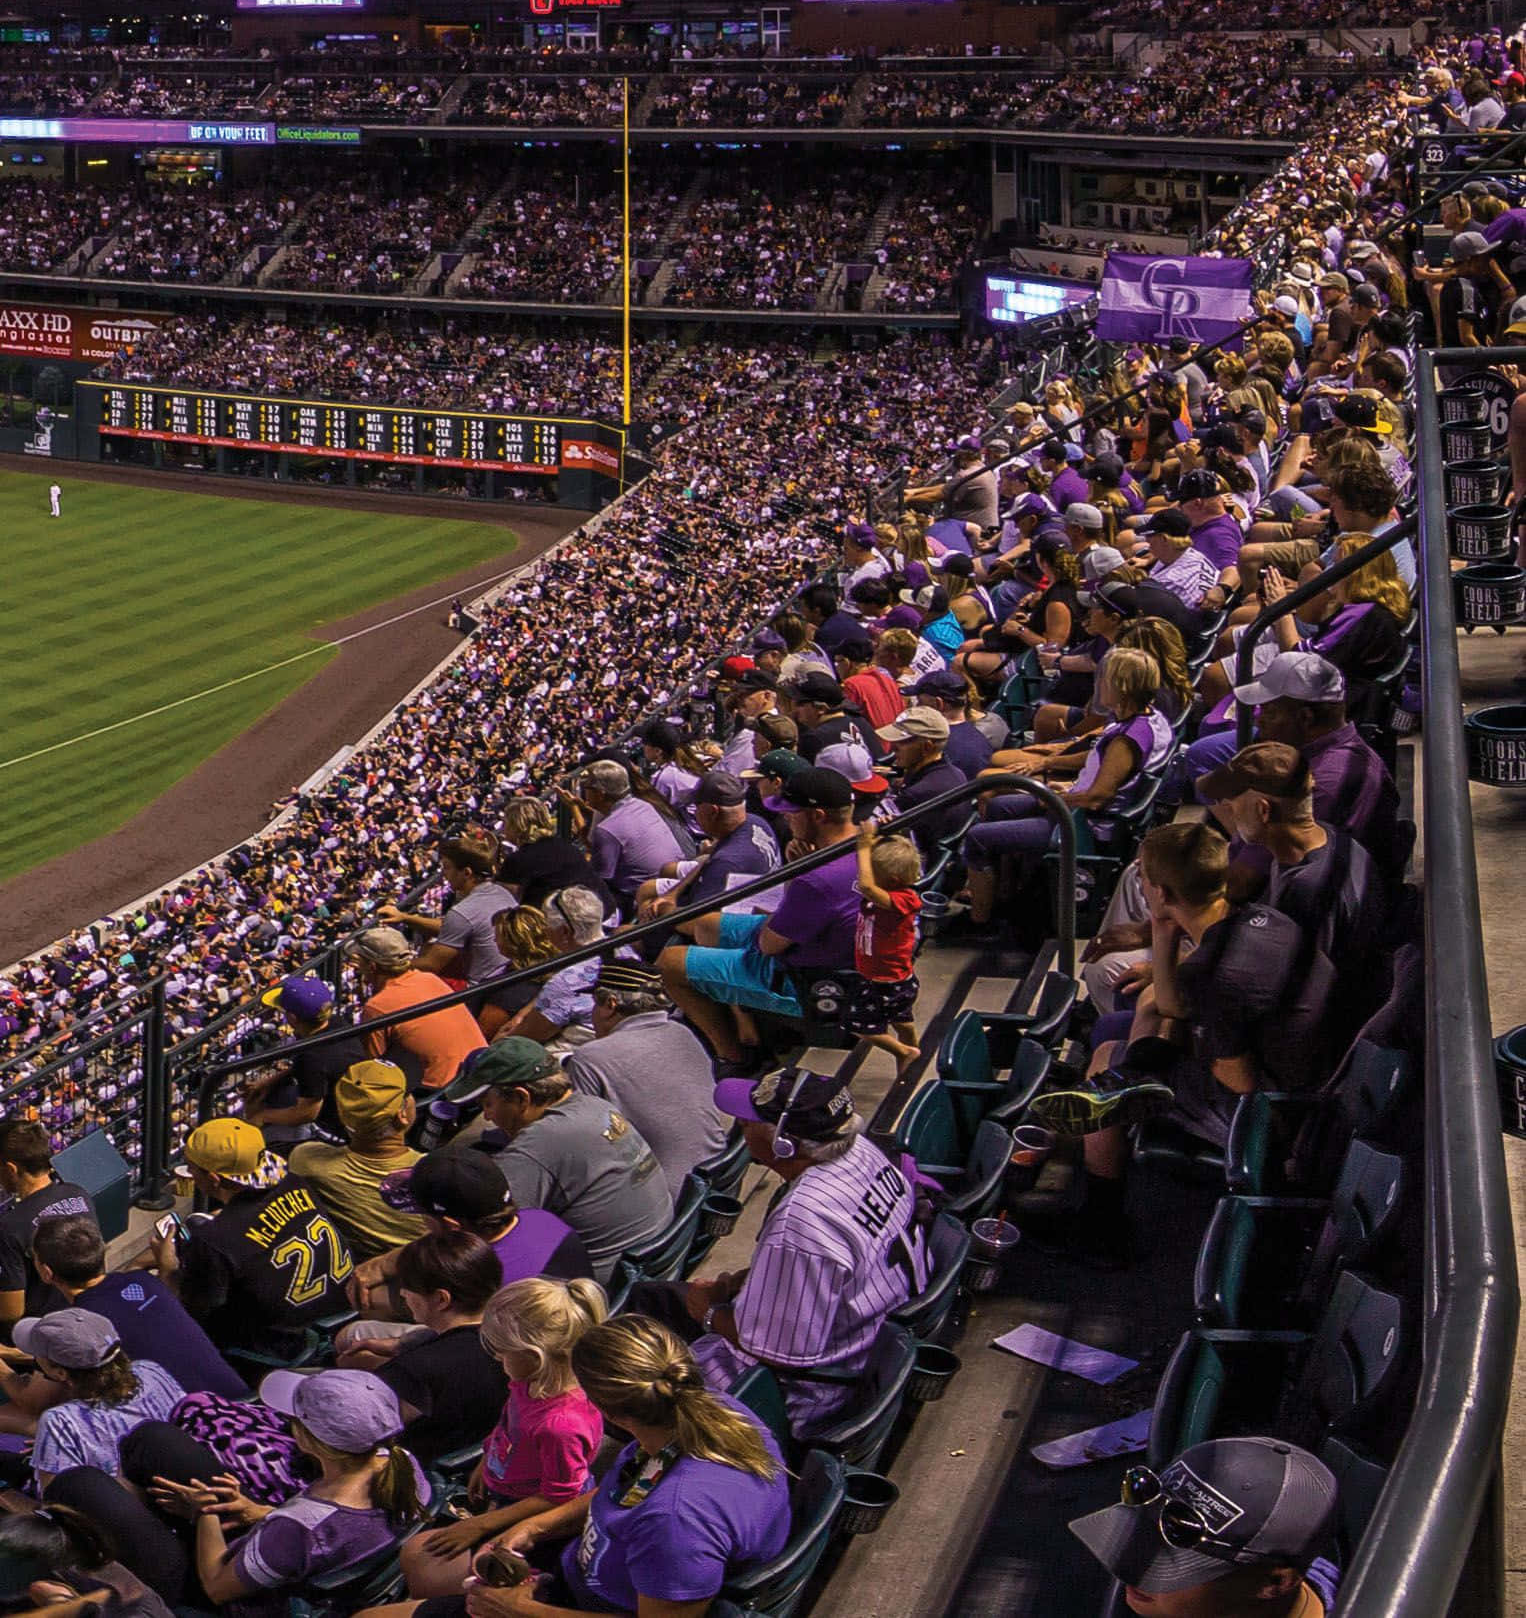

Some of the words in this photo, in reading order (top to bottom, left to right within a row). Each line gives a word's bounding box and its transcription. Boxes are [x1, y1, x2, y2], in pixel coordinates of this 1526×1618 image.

[189, 125, 203, 140] UP
[220, 126, 242, 141] YOUR
[1426, 149, 1444, 162] 323
[42, 313, 71, 332] HD
[1455, 523, 1488, 539] COORS
[1455, 538, 1489, 555] FIELD
[1464, 585, 1501, 603] COORS
[1464, 601, 1502, 621] FIELD
[1480, 737, 1526, 759] COORS
[244, 1187, 317, 1249] McCUTCHEN
[271, 1214, 355, 1308] 22
